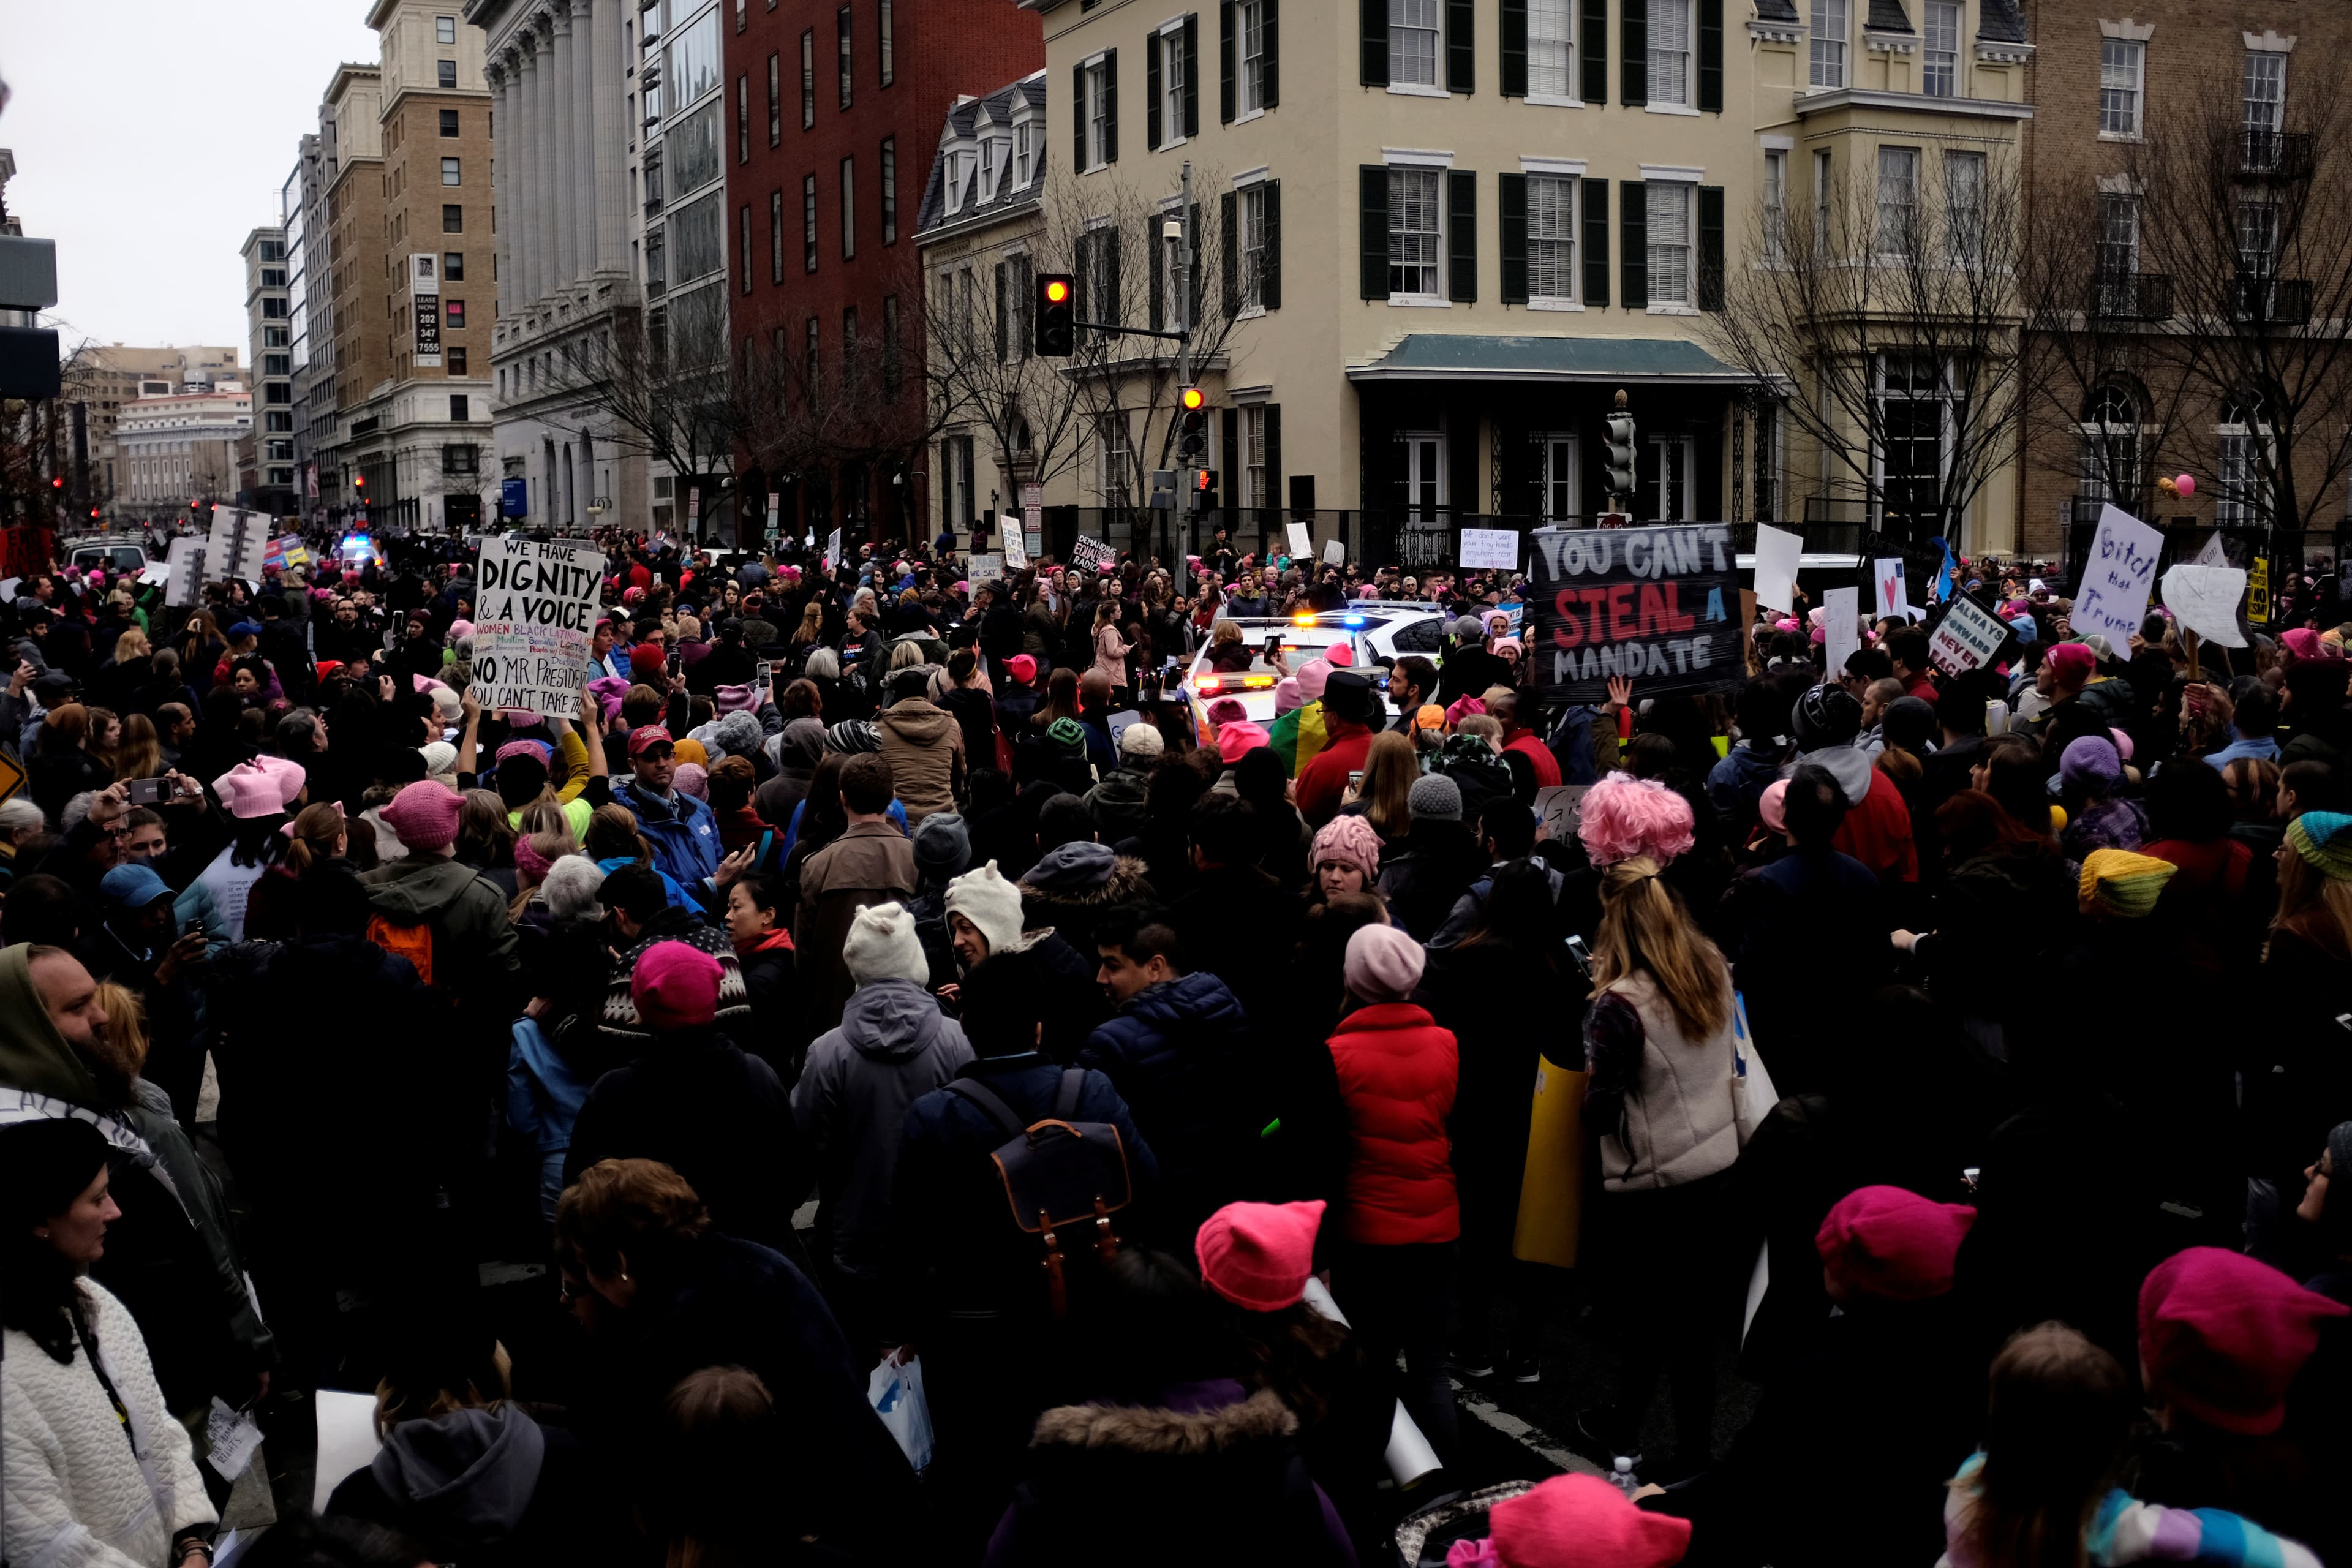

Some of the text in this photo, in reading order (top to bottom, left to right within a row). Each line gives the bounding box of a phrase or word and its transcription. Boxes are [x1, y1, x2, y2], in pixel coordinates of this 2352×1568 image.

[420, 314, 435, 323] 202
[420, 329, 436, 337] 347
[418, 343, 439, 352] 7555
[504, 540, 577, 562] WE HAVE
[1073, 542, 1098, 562] EQUAL
[1078, 534, 1117, 557] DEMANDING
[1466, 549, 1494, 558] anywhere
[1481, 540, 1494, 551] tiny
[1495, 540, 1513, 549] hands
[1537, 527, 1730, 581] YOU CAN'T
[482, 558, 602, 600] DIGNITY
[2107, 571, 2130, 593] that
[2253, 587, 2266, 603] NO
[478, 595, 593, 633] & A VOICE
[1553, 581, 1728, 648] STEAL A
[1954, 602, 2004, 641] ALWAYS
[2082, 586, 2137, 639] Trump
[476, 623, 510, 635] WOMEN
[514, 624, 546, 636] BLACK
[496, 635, 525, 644] Muslim
[1943, 614, 1991, 654] FORWARD
[529, 645, 548, 654] People
[1553, 635, 1713, 685] MANDATE
[1937, 630, 1980, 668] NEVER
[470, 656, 498, 685] NO,
[497, 687, 536, 709] CAN'T
[540, 691, 568, 714] TAKE
[571, 696, 582, 715] TH
[216, 1434, 241, 1463] RIGHTS
